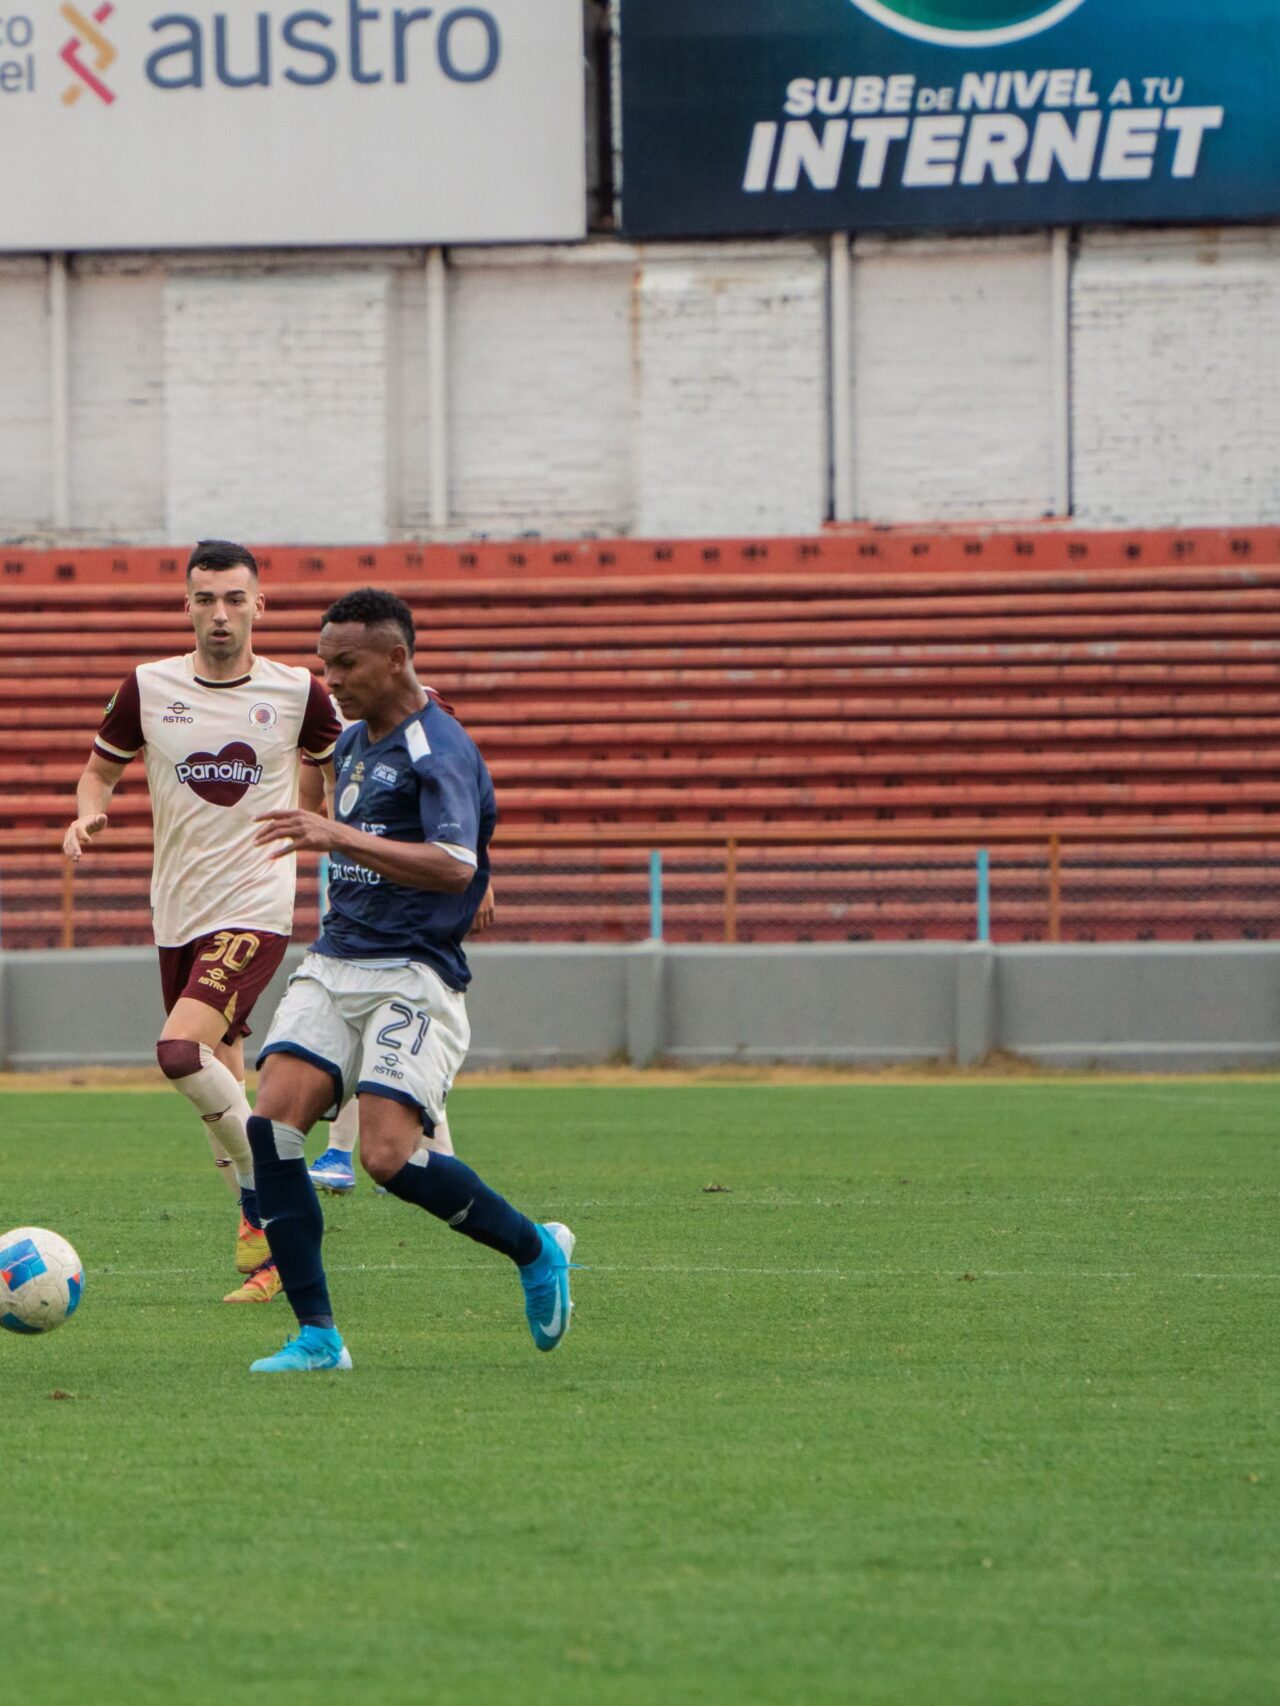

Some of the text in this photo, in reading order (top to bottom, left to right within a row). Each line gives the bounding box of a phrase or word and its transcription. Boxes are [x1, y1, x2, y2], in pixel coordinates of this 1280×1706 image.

[145, 0, 501, 89] austro
[783, 69, 1184, 115] SUBE DE NIVEL A TU
[742, 106, 1223, 192] INTERNET
[163, 716, 193, 724] ASTRO
[331, 864, 381, 884] austro
[200, 931, 260, 972] 30
[376, 1003, 431, 1056] 21
[372, 1065, 404, 1080] ASTRO
